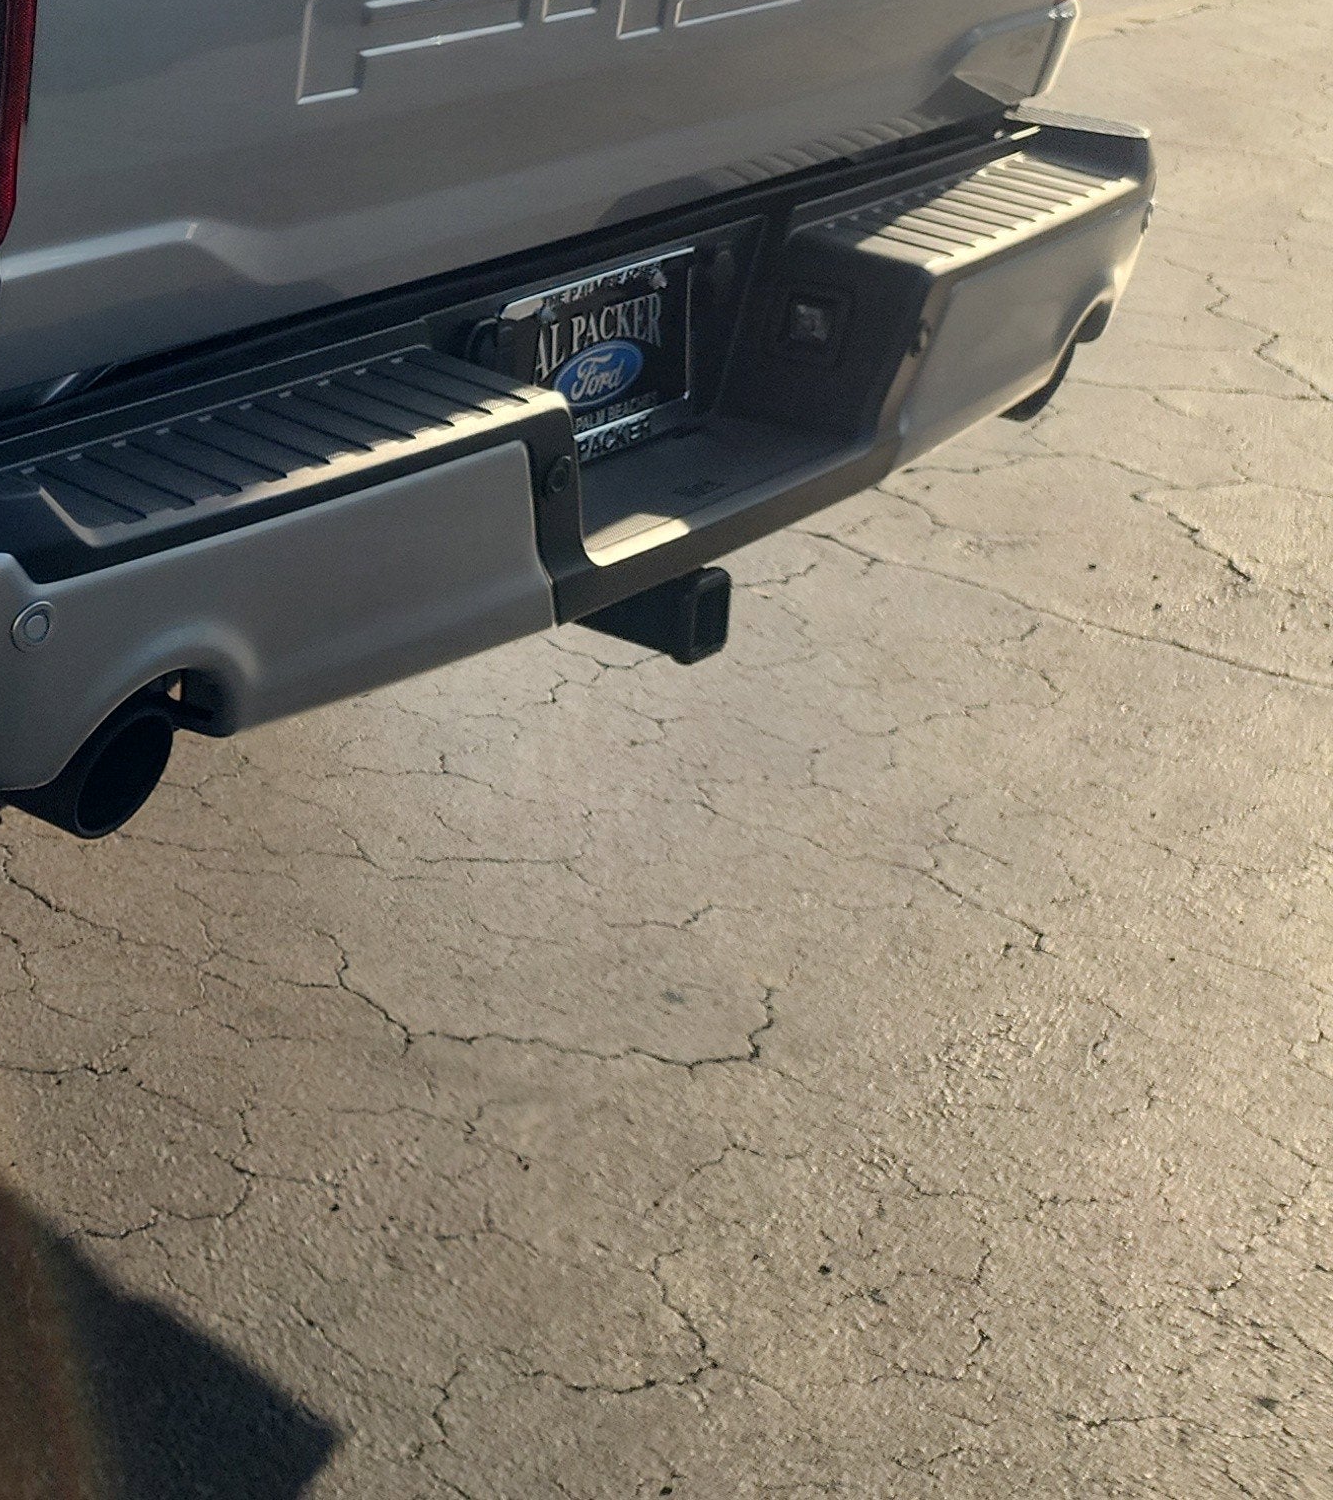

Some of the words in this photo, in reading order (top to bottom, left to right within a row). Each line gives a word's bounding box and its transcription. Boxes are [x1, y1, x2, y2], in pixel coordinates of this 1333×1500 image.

[535, 323, 566, 382] AL
[571, 292, 662, 353] PACKER
[569, 352, 626, 401] Ford
